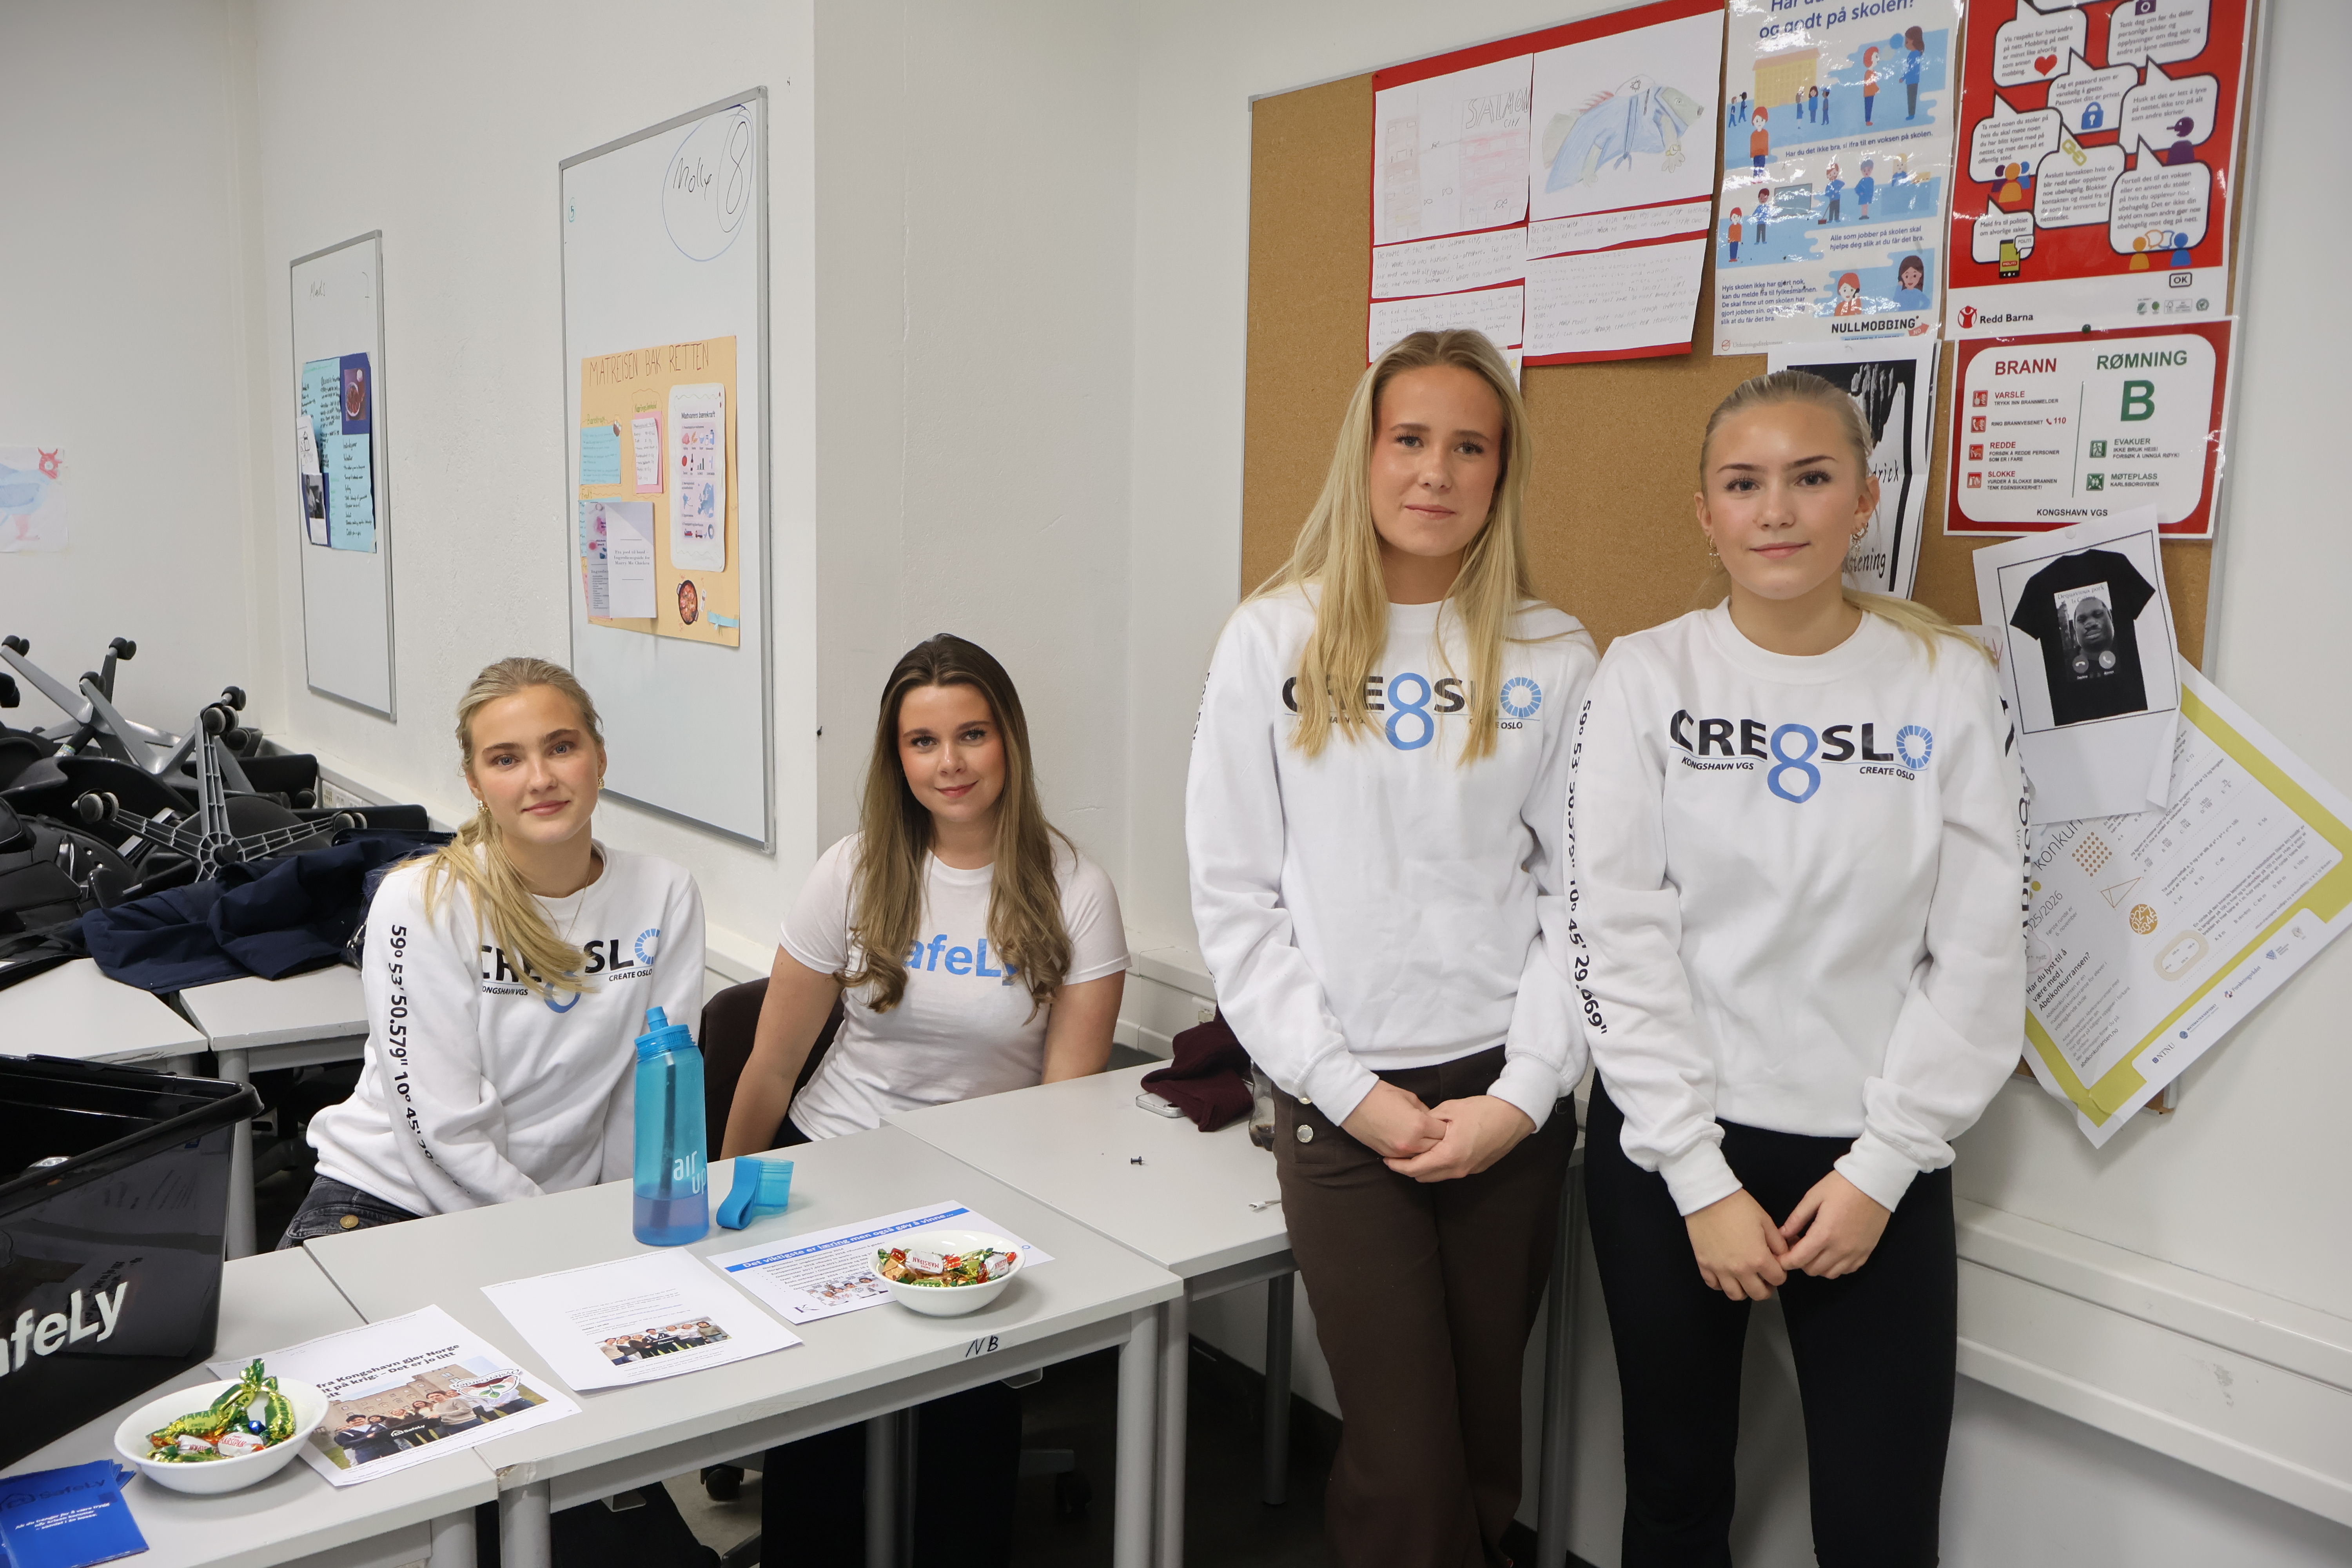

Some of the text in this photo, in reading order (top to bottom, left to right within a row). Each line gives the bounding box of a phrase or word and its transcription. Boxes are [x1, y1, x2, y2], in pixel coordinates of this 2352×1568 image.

[1826, 6, 1846, 29] på
[1466, 87, 1530, 129] SALMON
[1901, 133, 1909, 142] på
[1911, 131, 1933, 139] skolen.
[673, 157, 712, 200] Molly
[726, 121, 748, 214] 8
[1857, 231, 1878, 240] jobber
[1831, 318, 1915, 333] NULLMOBBING
[1980, 314, 2033, 323] Redd Barna
[589, 342, 709, 387] MATREISEN BAK RETTEN
[1995, 358, 2056, 375] BRANN
[2097, 350, 2187, 370] RØMNING
[2121, 379, 2155, 421] B
[1501, 722, 1523, 730] OSLO
[1681, 757, 1734, 770] KONGSHAVN
[1859, 766, 1895, 776] CREATE
[1896, 769, 1915, 780] OSLO
[2027, 890, 2063, 931] 25/2026
[2045, 922, 2058, 936] Første
[2057, 911, 2069, 924] runde
[2060, 911, 2078, 933] november
[902, 933, 1018, 986] afeL
[482, 986, 515, 995] ONGSHAVN
[609, 970, 635, 982] CREATE
[637, 969, 652, 977] OSLO
[2026, 982, 2037, 995] Har
[2037, 973, 2046, 984] du
[2044, 961, 2057, 975] lyst
[2033, 987, 2048, 1002] være
[2047, 972, 2060, 987] med
[2038, 952, 2091, 1011] Abelkonkurransen?
[2081, 1028, 2118, 1068] abelkonkurransen.no
[2156, 1042, 2175, 1060] NTNU
[673, 1150, 697, 1181] air
[691, 1167, 706, 1195] up
[763, 1250, 804, 1263] viktigste
[817, 1239, 851, 1250] læring
[850, 1233, 872, 1241] men
[873, 1227, 895, 1236] også
[913, 1256, 939, 1269] MARSIPAN
[0, 1281, 129, 1377] feLy
[316, 1344, 460, 1388] fra Kongshavn gjør Norge
[335, 1383, 349, 1391] på
[350, 1374, 379, 1385] krig:
[388, 1364, 410, 1373] Det
[436, 1352, 456, 1360] litt
[403, 1424, 425, 1433] SafeLy
